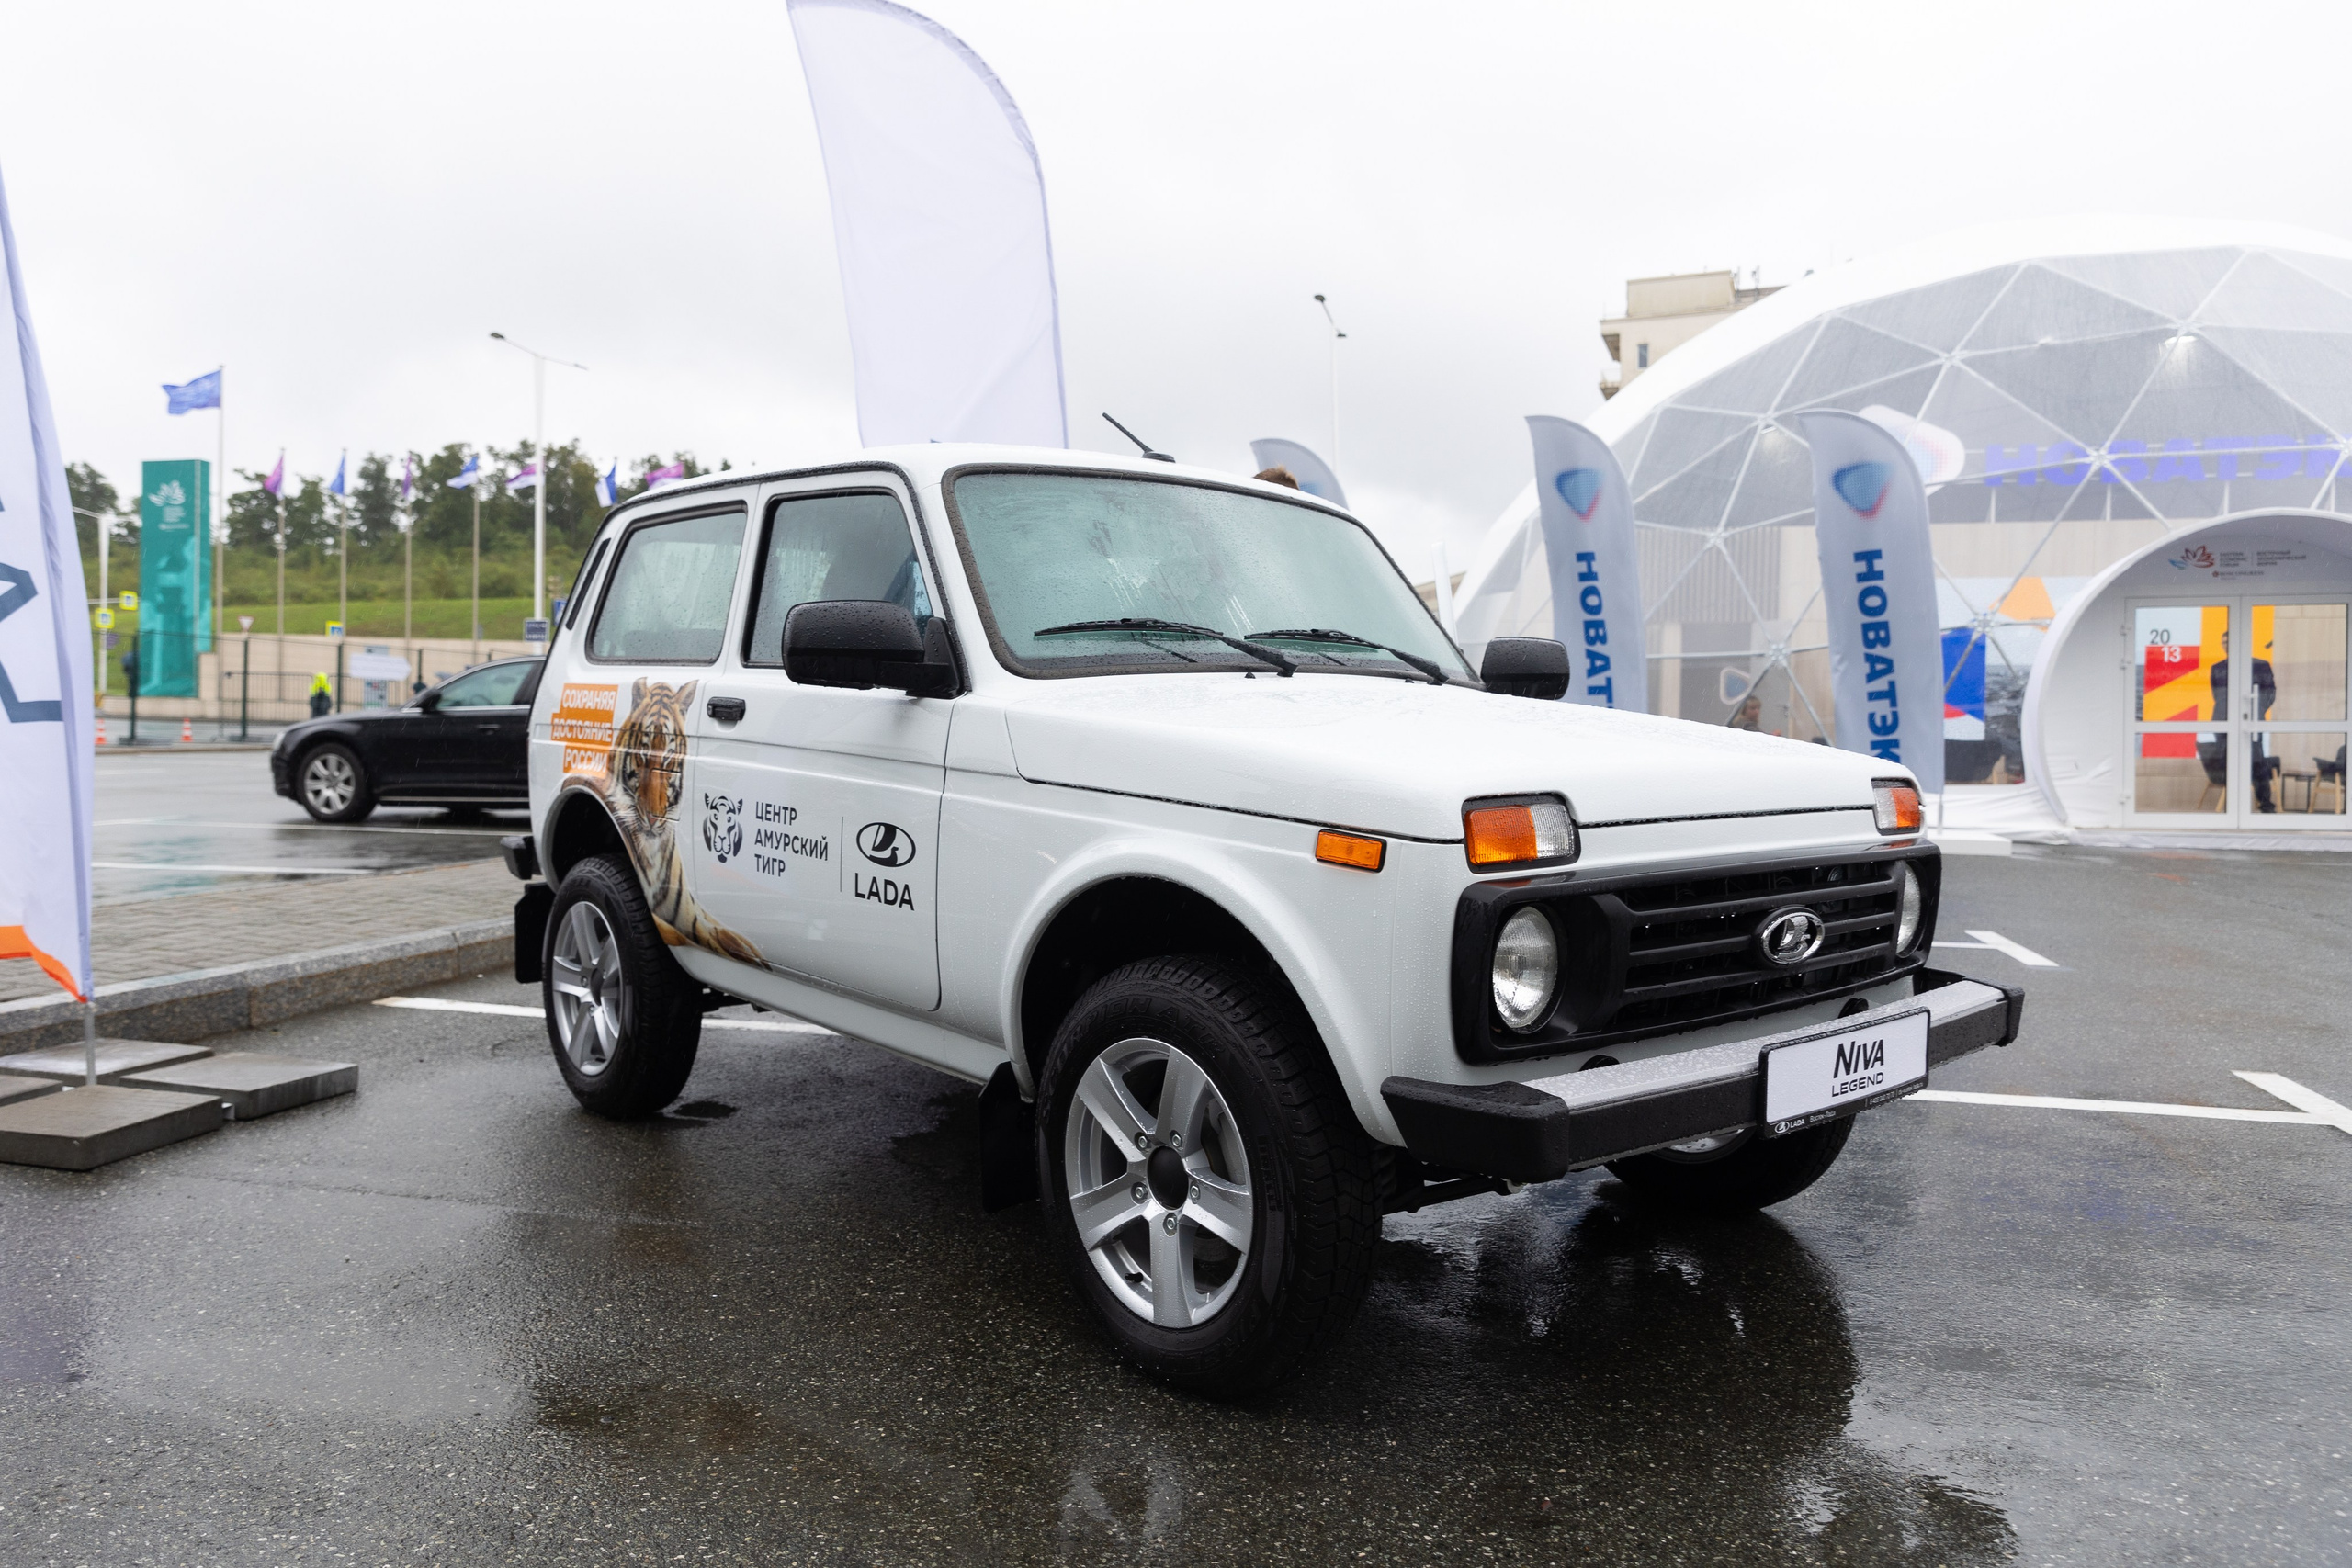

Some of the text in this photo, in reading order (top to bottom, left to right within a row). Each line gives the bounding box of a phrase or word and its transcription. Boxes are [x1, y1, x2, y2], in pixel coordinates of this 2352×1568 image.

[1576, 551, 1614, 708] НОВАТ
[2150, 629, 2170, 645] 20
[2161, 645, 2181, 662] 13
[562, 689, 616, 711] СОХРАНЯЯ
[552, 718, 612, 742] ДОСТОЯНИЕ
[565, 749, 607, 772] РОССИИ
[755, 801, 797, 826] ЦЕНТР
[754, 828, 828, 861] АМУРСКИЙ
[754, 853, 786, 877] ТИГР
[854, 873, 915, 911] LADA
[1831, 1072, 1884, 1097] LEGEND
[1790, 1118, 1805, 1129] LADA
